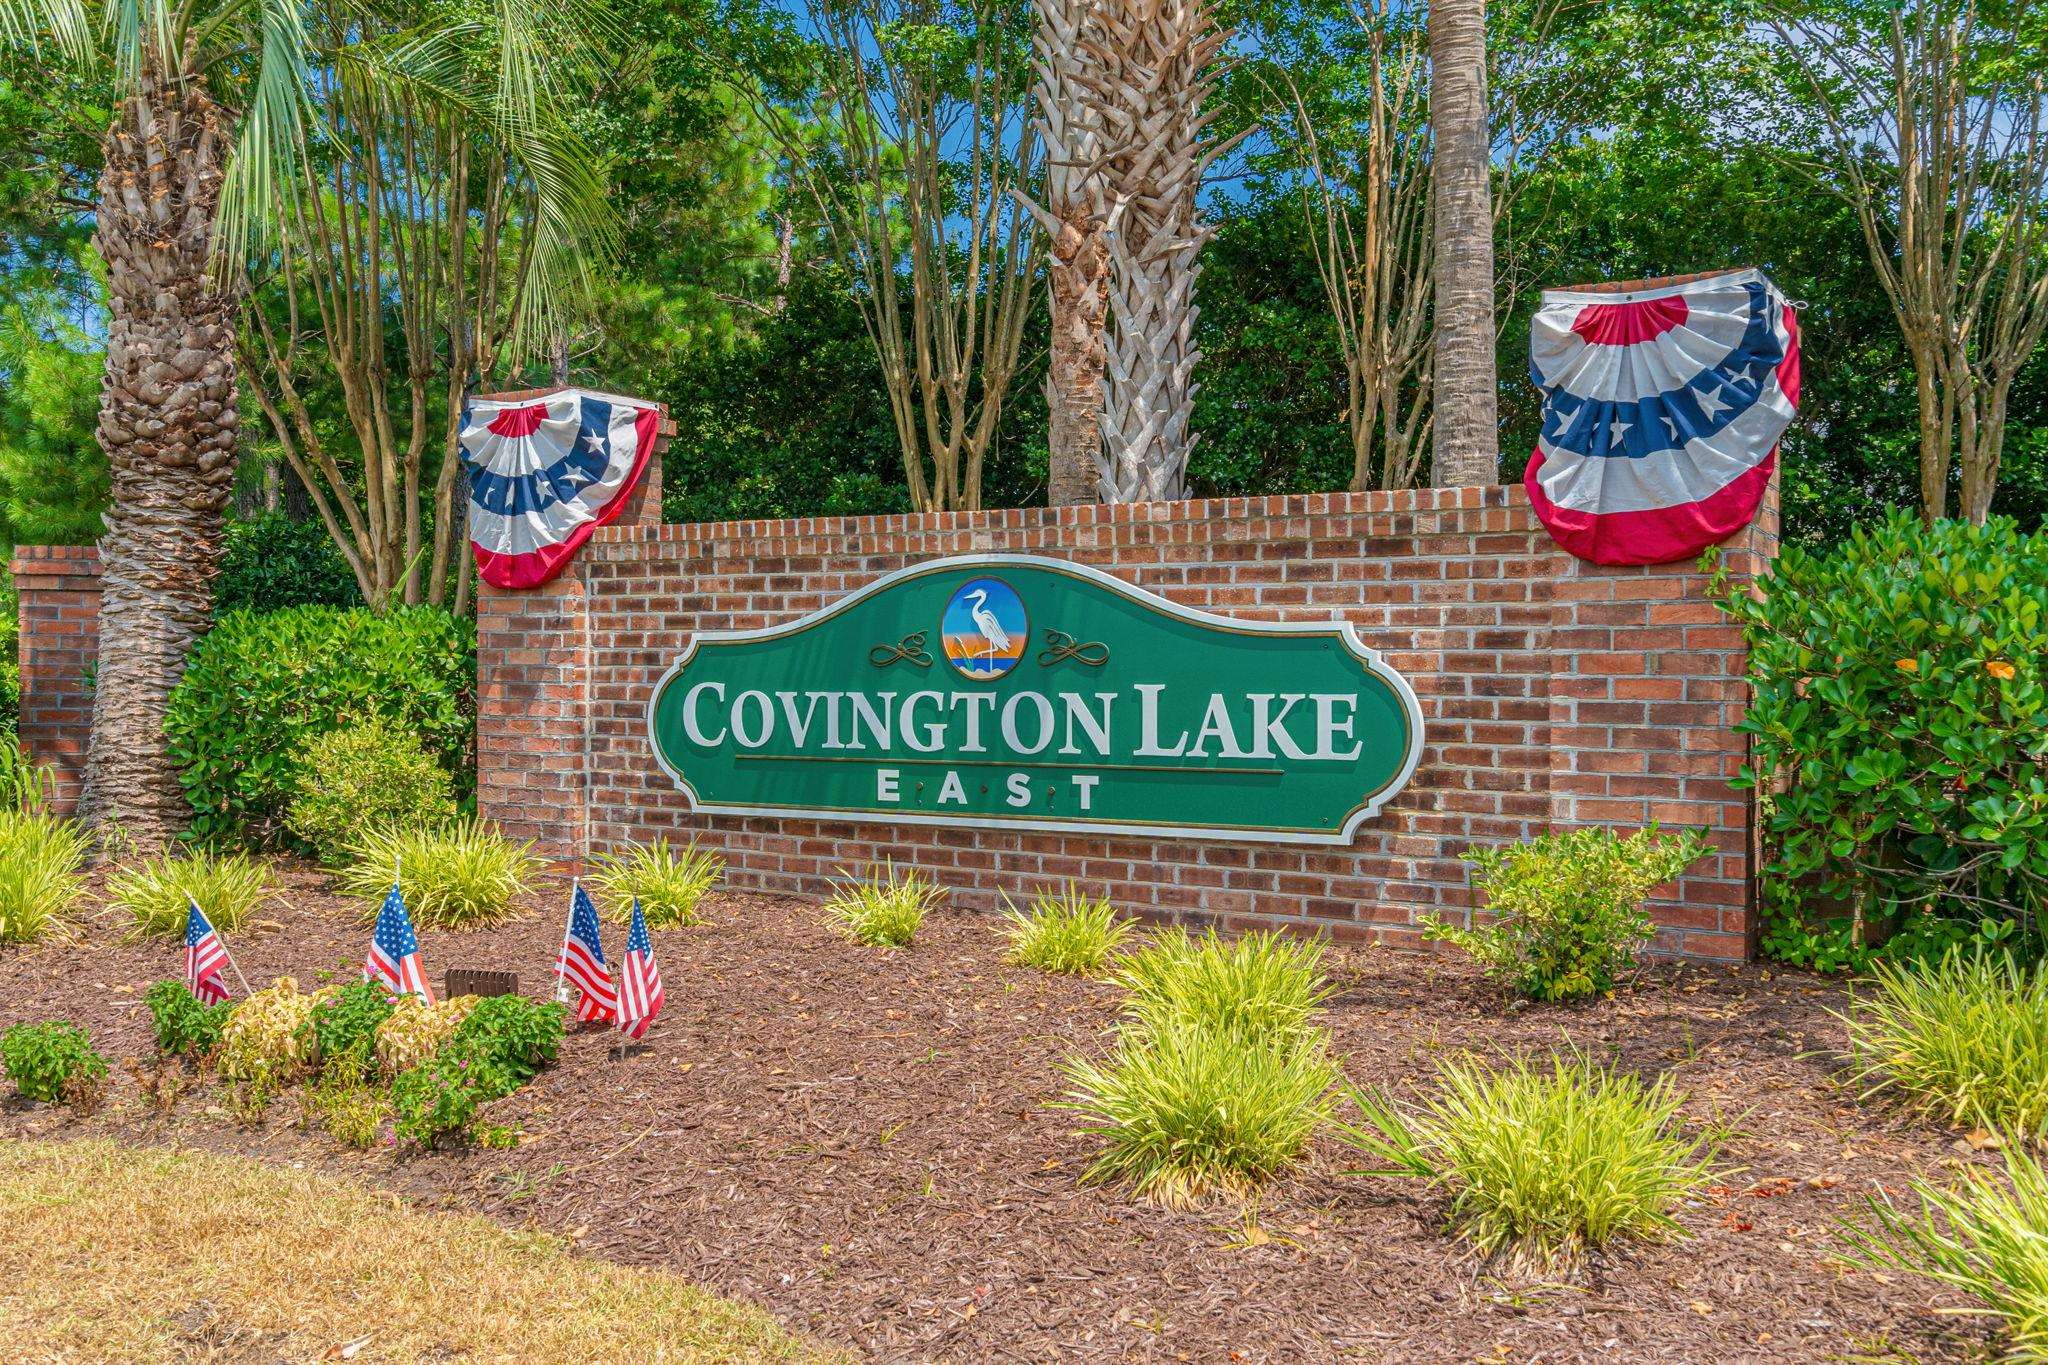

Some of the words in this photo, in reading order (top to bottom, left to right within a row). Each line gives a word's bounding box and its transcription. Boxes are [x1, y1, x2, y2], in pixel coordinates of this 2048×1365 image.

[682, 681, 1119, 756] COVINGTON
[1133, 683, 1364, 761] LAKE
[877, 768, 1100, 810] EAST
